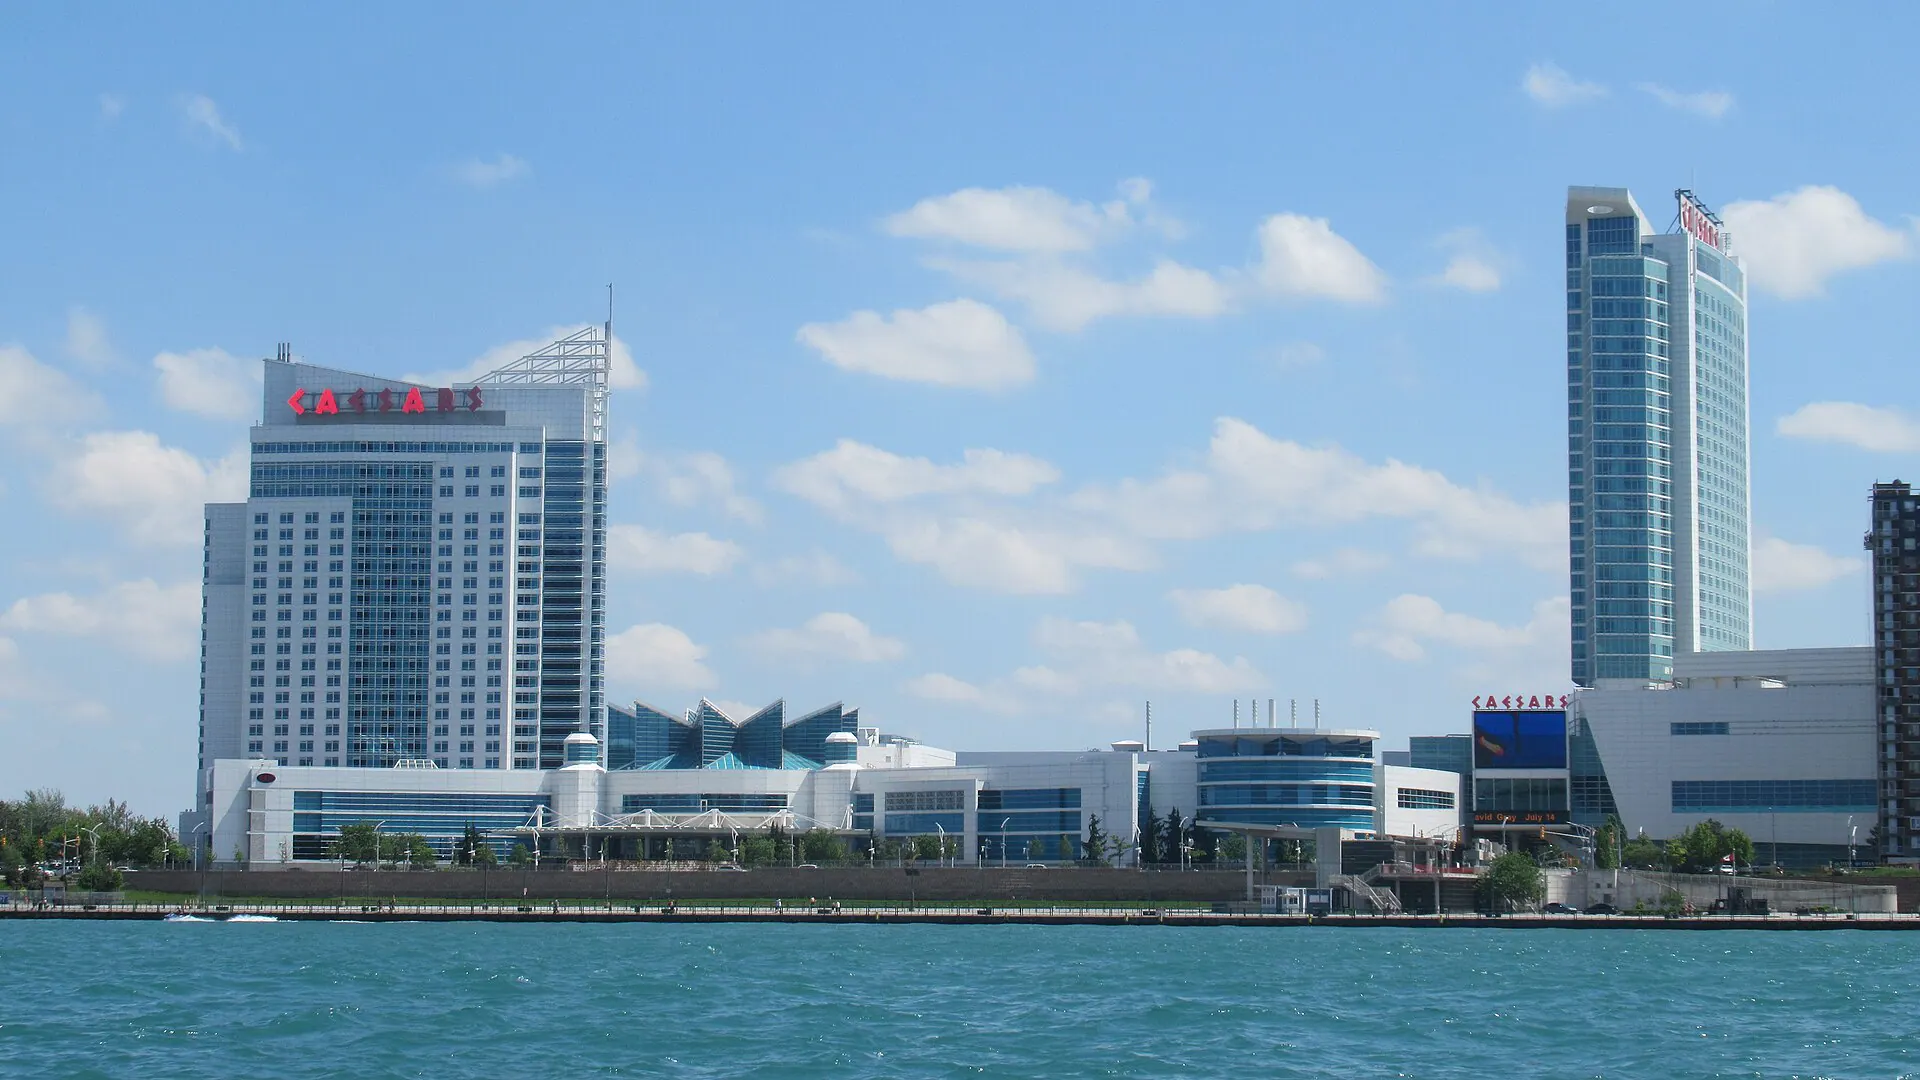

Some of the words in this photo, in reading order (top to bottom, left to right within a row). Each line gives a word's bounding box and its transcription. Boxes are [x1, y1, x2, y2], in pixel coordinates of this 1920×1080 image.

[287, 386, 484, 415] CAESARS
[1472, 695, 1568, 709] CAESARS
[1525, 813, 1542, 822] July
[1546, 813, 1555, 821] 14
